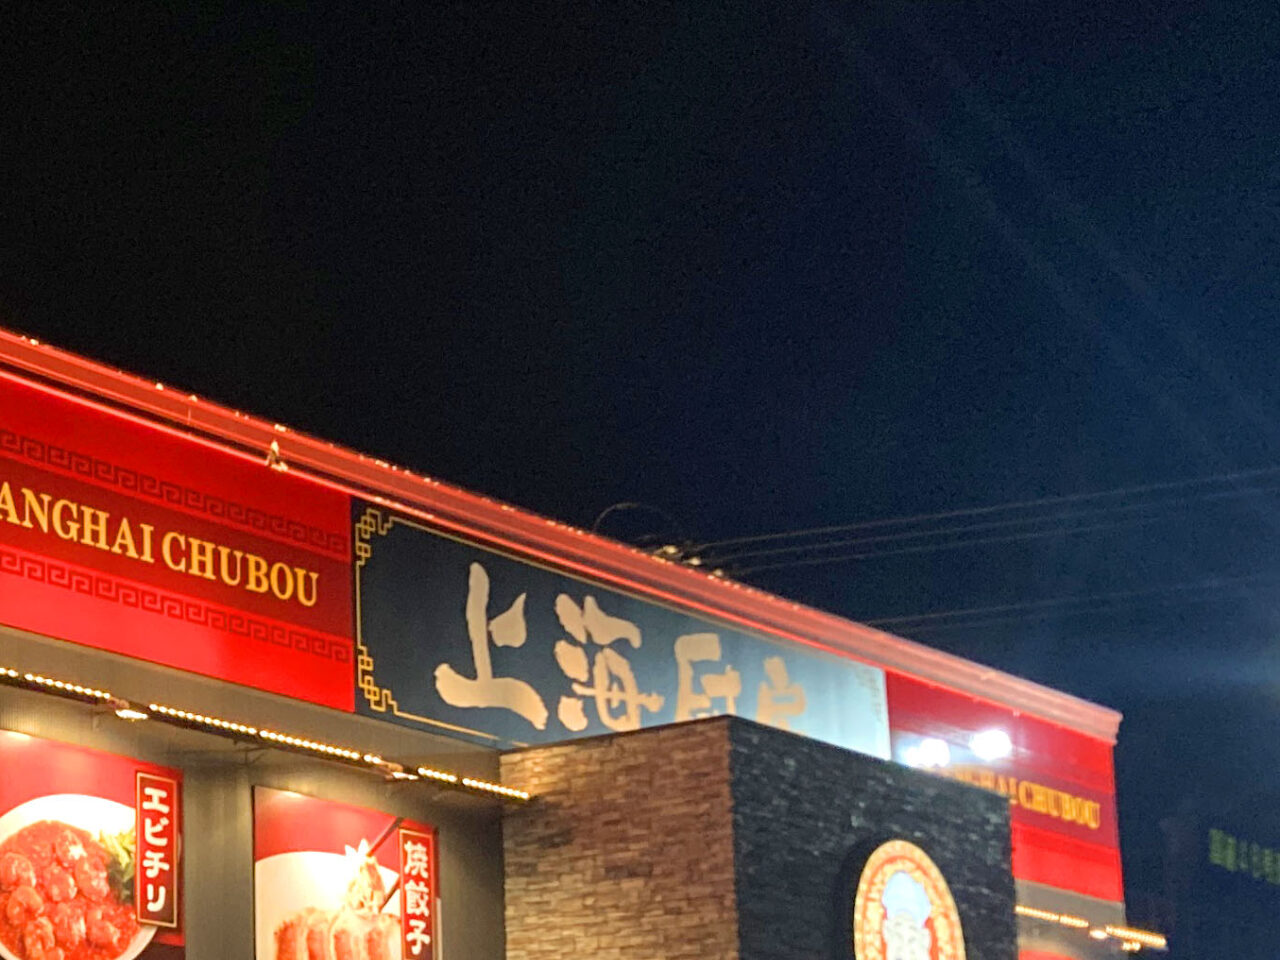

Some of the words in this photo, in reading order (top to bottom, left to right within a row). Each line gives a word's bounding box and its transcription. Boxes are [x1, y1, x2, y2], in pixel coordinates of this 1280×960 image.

[161, 530, 320, 607] CHUBOU
[142, 787, 170, 912] エビチリ
[404, 841, 431, 956] 焼餃子
